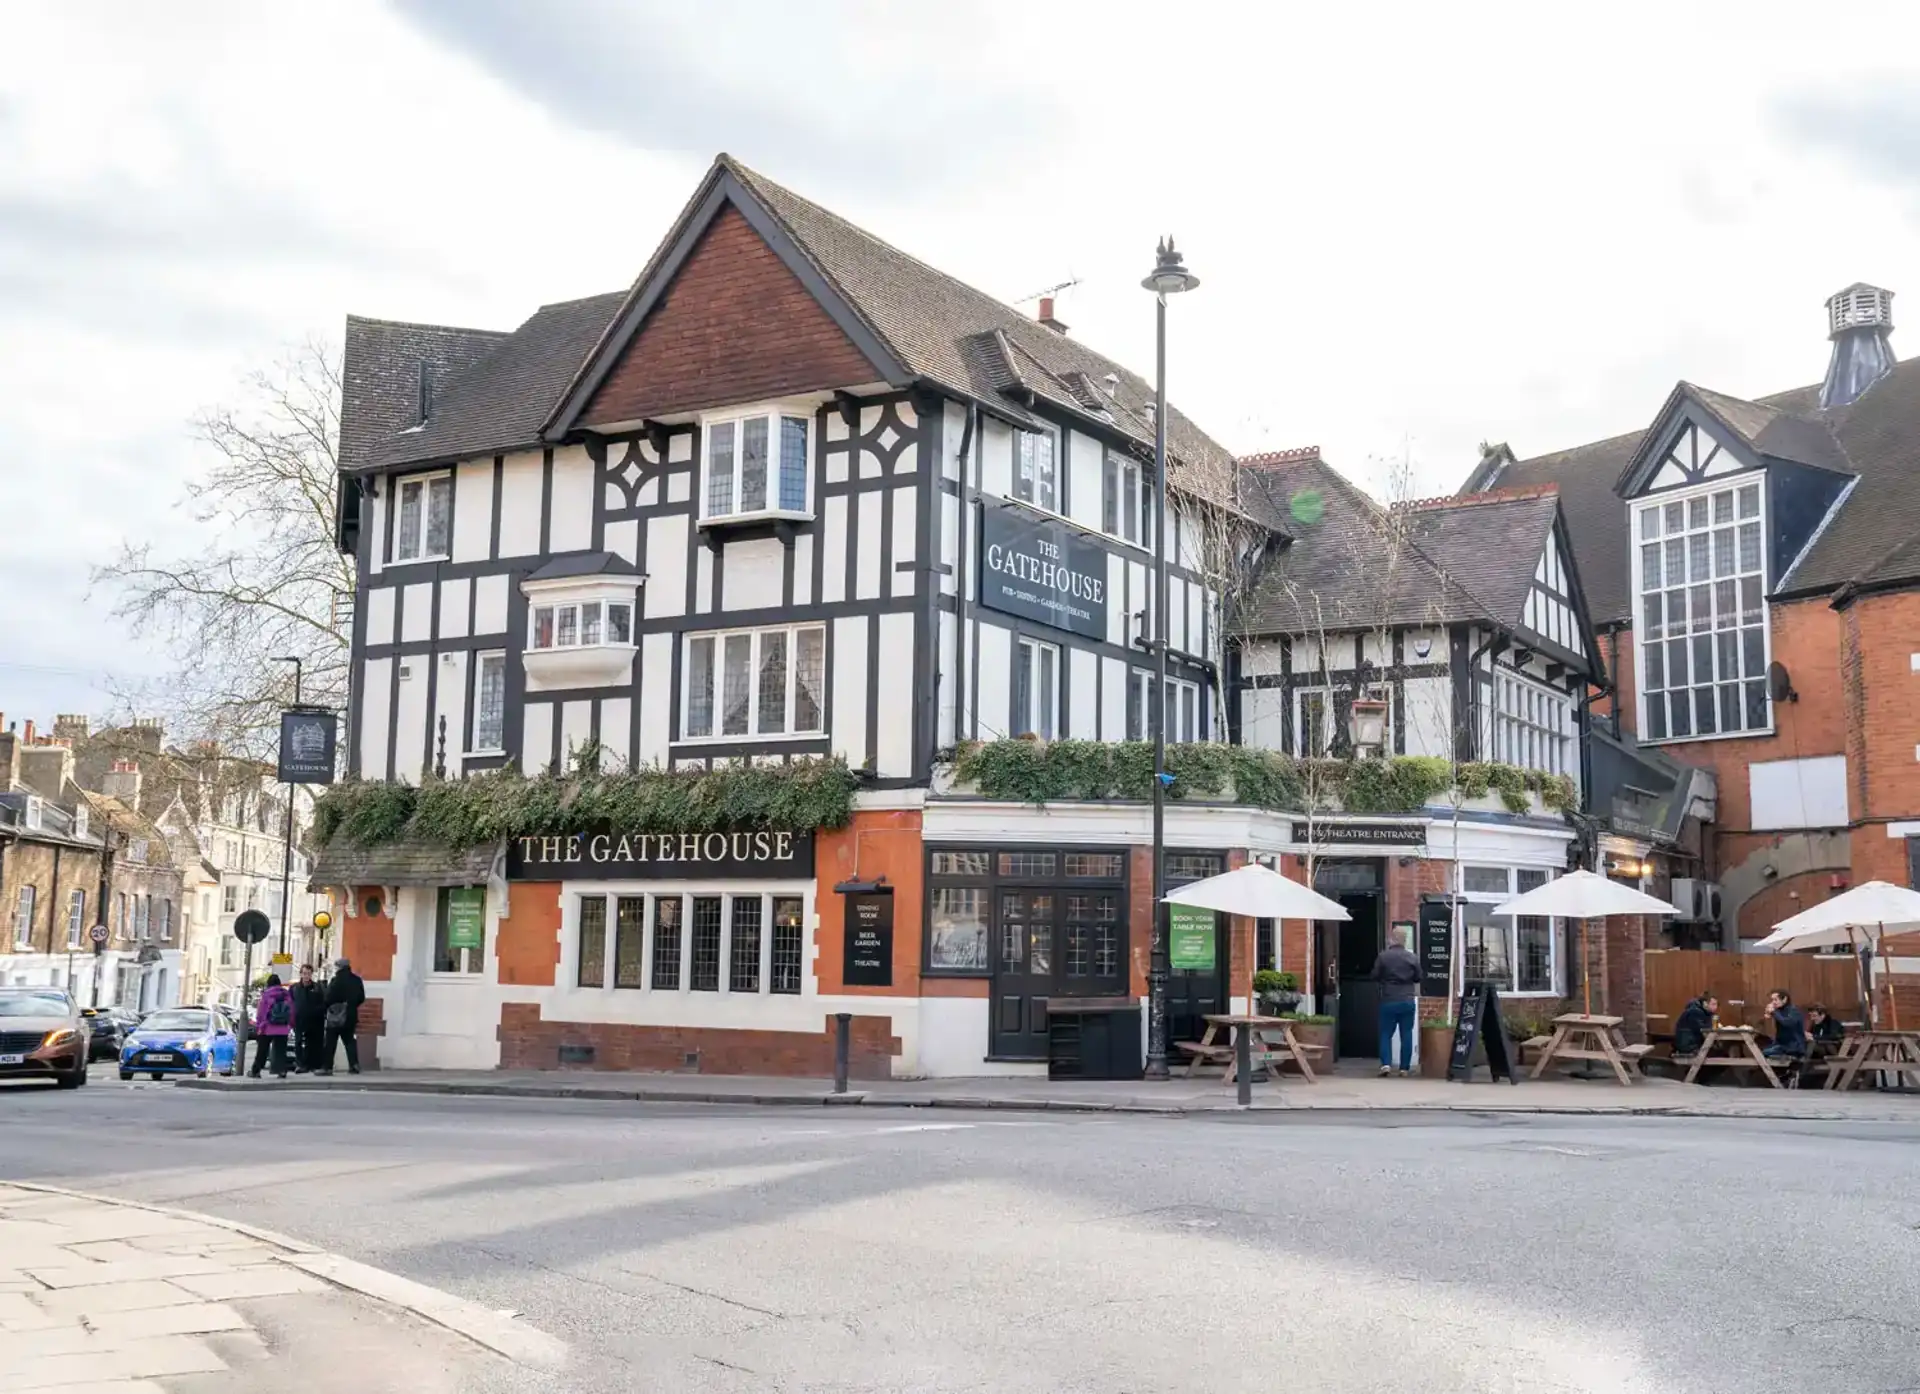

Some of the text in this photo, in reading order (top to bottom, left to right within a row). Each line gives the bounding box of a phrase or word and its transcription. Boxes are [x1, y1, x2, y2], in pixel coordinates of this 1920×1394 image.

[1037, 539, 1060, 560] THE
[988, 543, 1104, 604] GATEHOUSE
[1327, 828, 1371, 838] THEATRE
[1374, 830, 1423, 839] ENTRANCE
[519, 831, 794, 863] THE GATEHOUSE
[92, 928, 107, 938] 20
[854, 959, 880, 967] THEATRE
